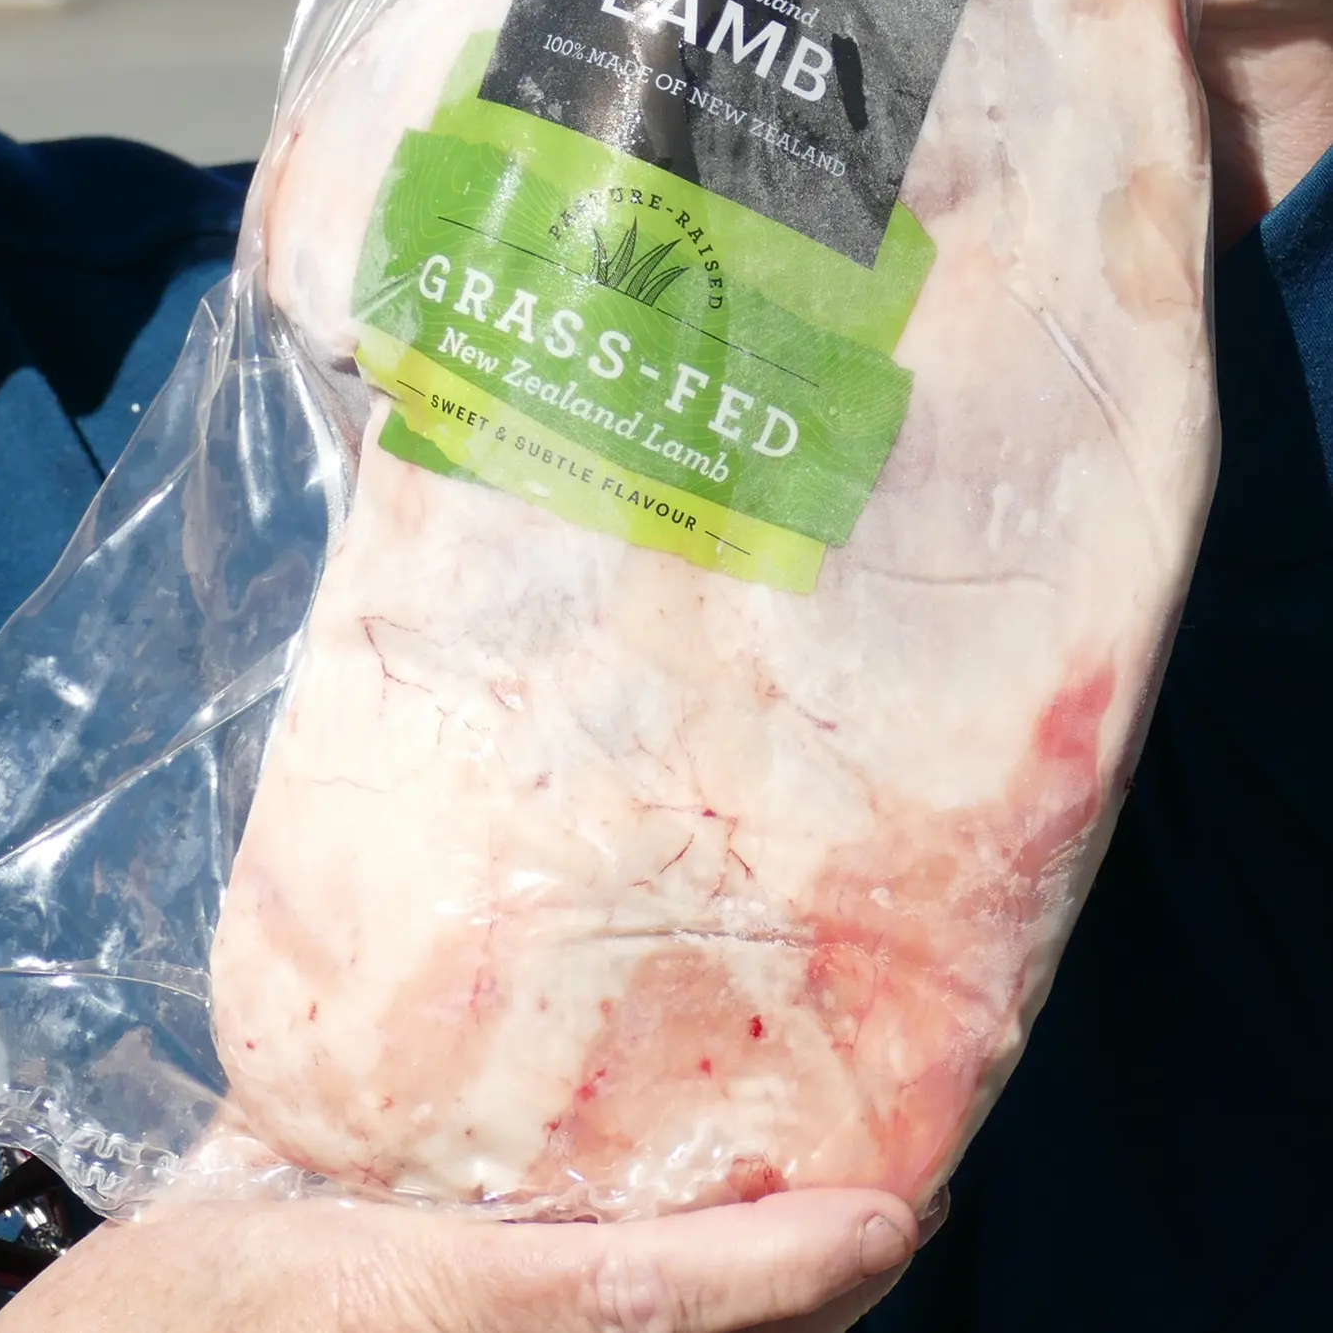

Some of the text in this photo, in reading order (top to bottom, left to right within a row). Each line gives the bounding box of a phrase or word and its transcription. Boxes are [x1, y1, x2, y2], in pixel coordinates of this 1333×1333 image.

[542, 33, 847, 179] 100% MADE OF NEW ZEALAND
[418, 254, 800, 458] GRASS-FED
[437, 326, 731, 484] New Zealand Lamb
[430, 393, 699, 533] SWEET & SUBTLE FLAVOUR
